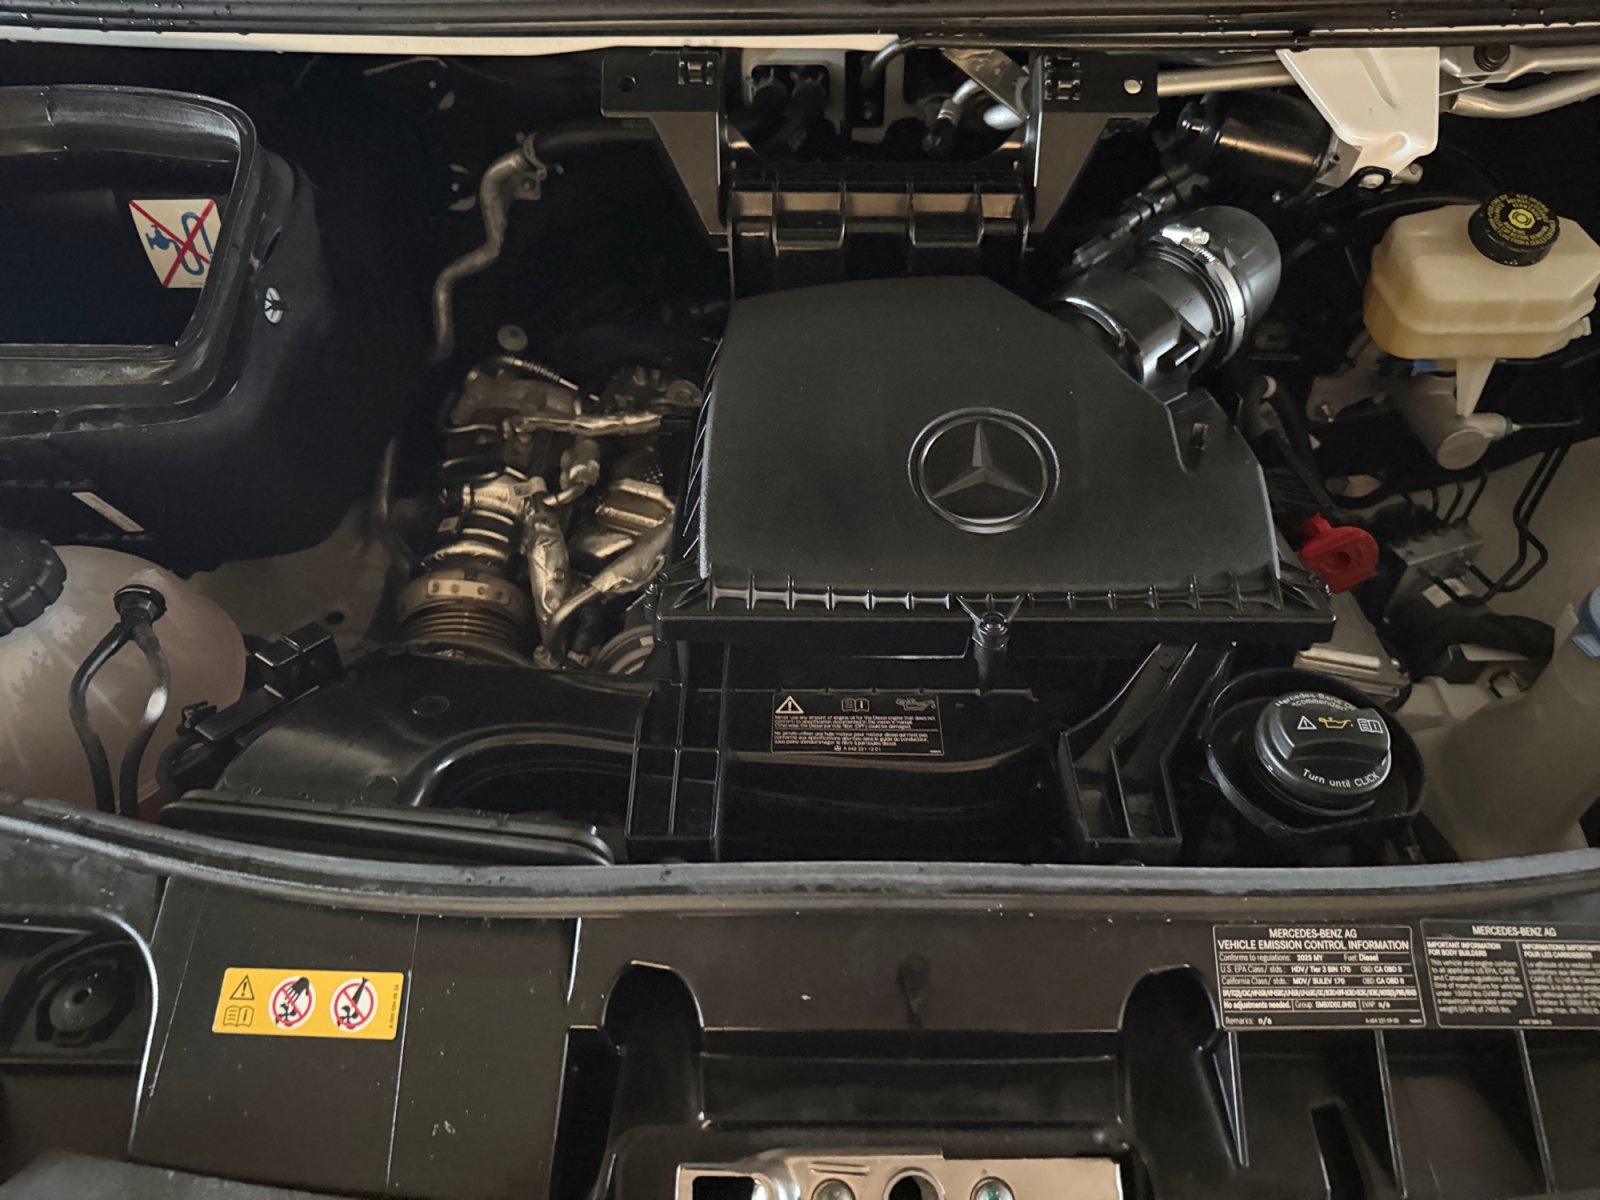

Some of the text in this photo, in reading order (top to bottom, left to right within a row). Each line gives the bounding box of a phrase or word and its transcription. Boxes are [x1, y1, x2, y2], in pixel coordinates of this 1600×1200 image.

[1303, 768, 1379, 788] Turn until CLICK
[1269, 928, 1357, 938] MERCEDES-BENZ AG
[1472, 926, 1557, 936] MERCEDES-BENZ AG
[1218, 940, 1409, 950] VEHICLE EMISSION CONTROL INFORMATION
[1224, 1001, 1233, 1009] No
[1258, 1016, 1272, 1025] n/a
